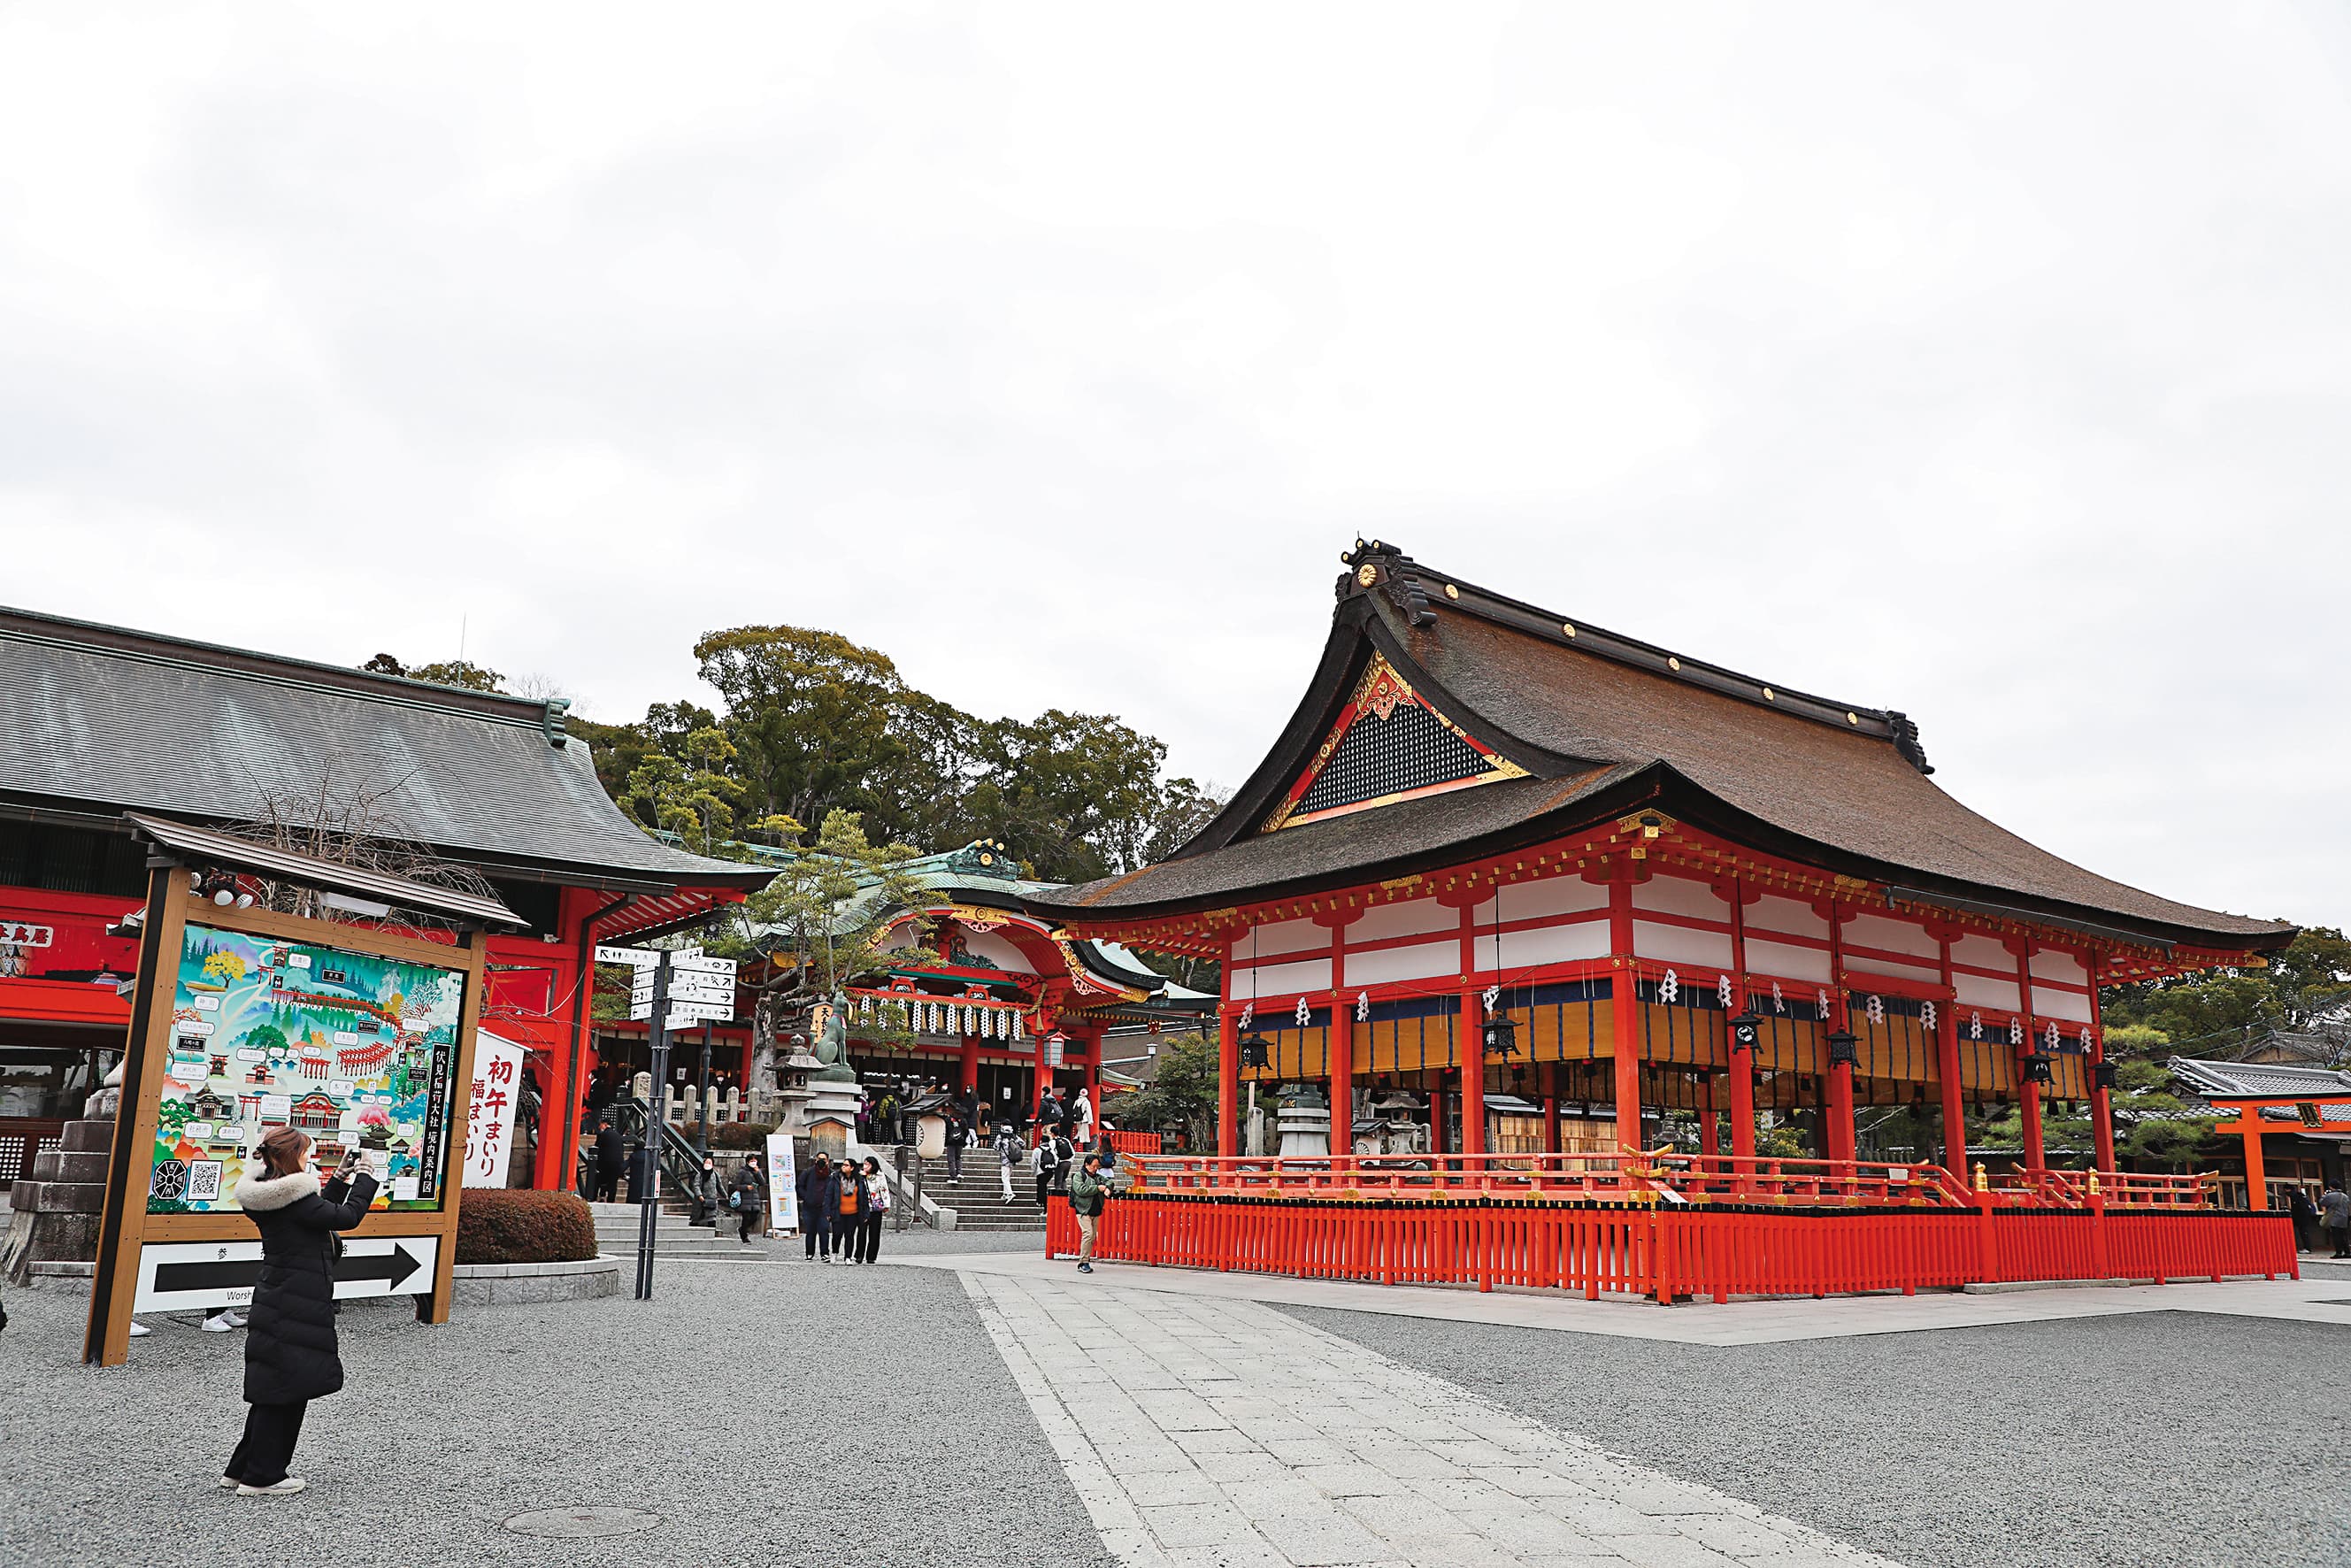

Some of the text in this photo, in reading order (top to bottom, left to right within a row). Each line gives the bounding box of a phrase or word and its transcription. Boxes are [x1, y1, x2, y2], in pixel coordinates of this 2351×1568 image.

[422, 1050, 446, 1193] 伏見稲荷大社 境内案内図
[465, 1078, 486, 1161] 福まいり
[481, 1054, 513, 1177] 初午まいり
